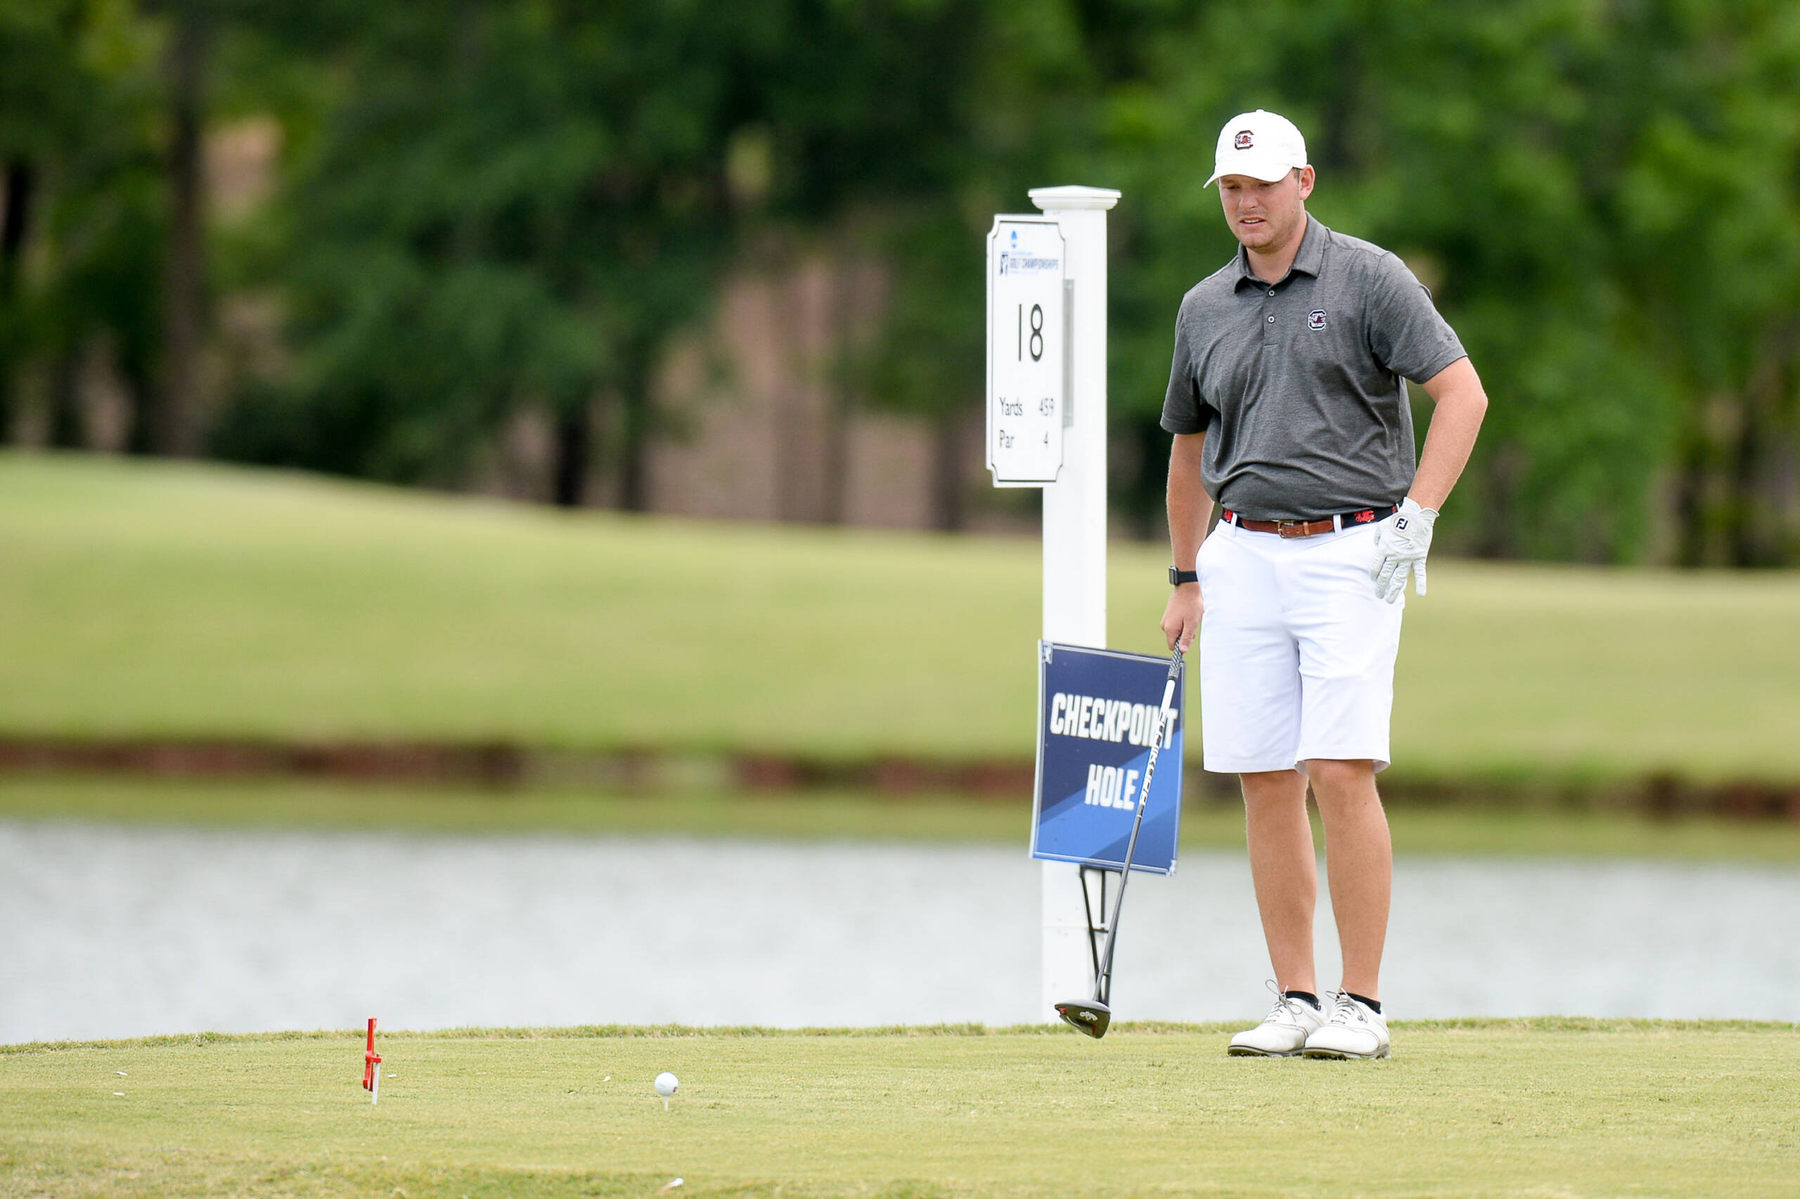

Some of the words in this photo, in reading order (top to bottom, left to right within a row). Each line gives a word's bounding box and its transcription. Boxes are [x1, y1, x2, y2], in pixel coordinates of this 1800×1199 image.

[1018, 303, 1044, 363] 18
[999, 396, 1023, 417] Yards
[1039, 397, 1055, 417] 459
[999, 429, 1015, 449] Par
[1043, 430, 1049, 449] 4
[1395, 517, 1409, 531] FJ
[1084, 763, 1139, 811] HOLE
